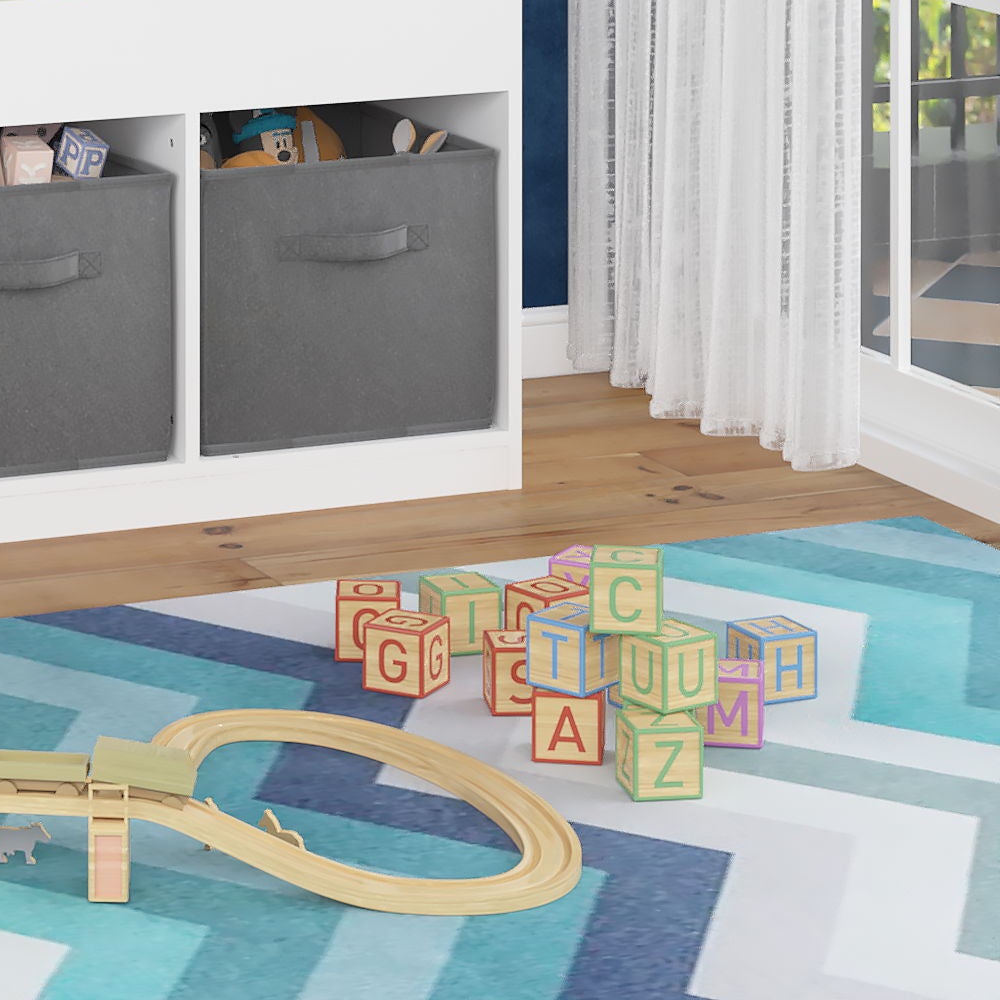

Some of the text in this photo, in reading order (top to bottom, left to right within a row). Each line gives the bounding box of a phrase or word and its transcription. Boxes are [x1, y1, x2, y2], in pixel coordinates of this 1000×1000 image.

[60, 135, 80, 163] P
[80, 149, 104, 176] P
[608, 576, 643, 623] C
[378, 638, 408, 683] G
[429, 634, 443, 681] G
[541, 630, 569, 680] T
[631, 644, 654, 695] U
[678, 648, 705, 698] U
[775, 644, 803, 692] H
[547, 705, 587, 753] A
[706, 690, 748, 737] M
[653, 740, 685, 789] Z
